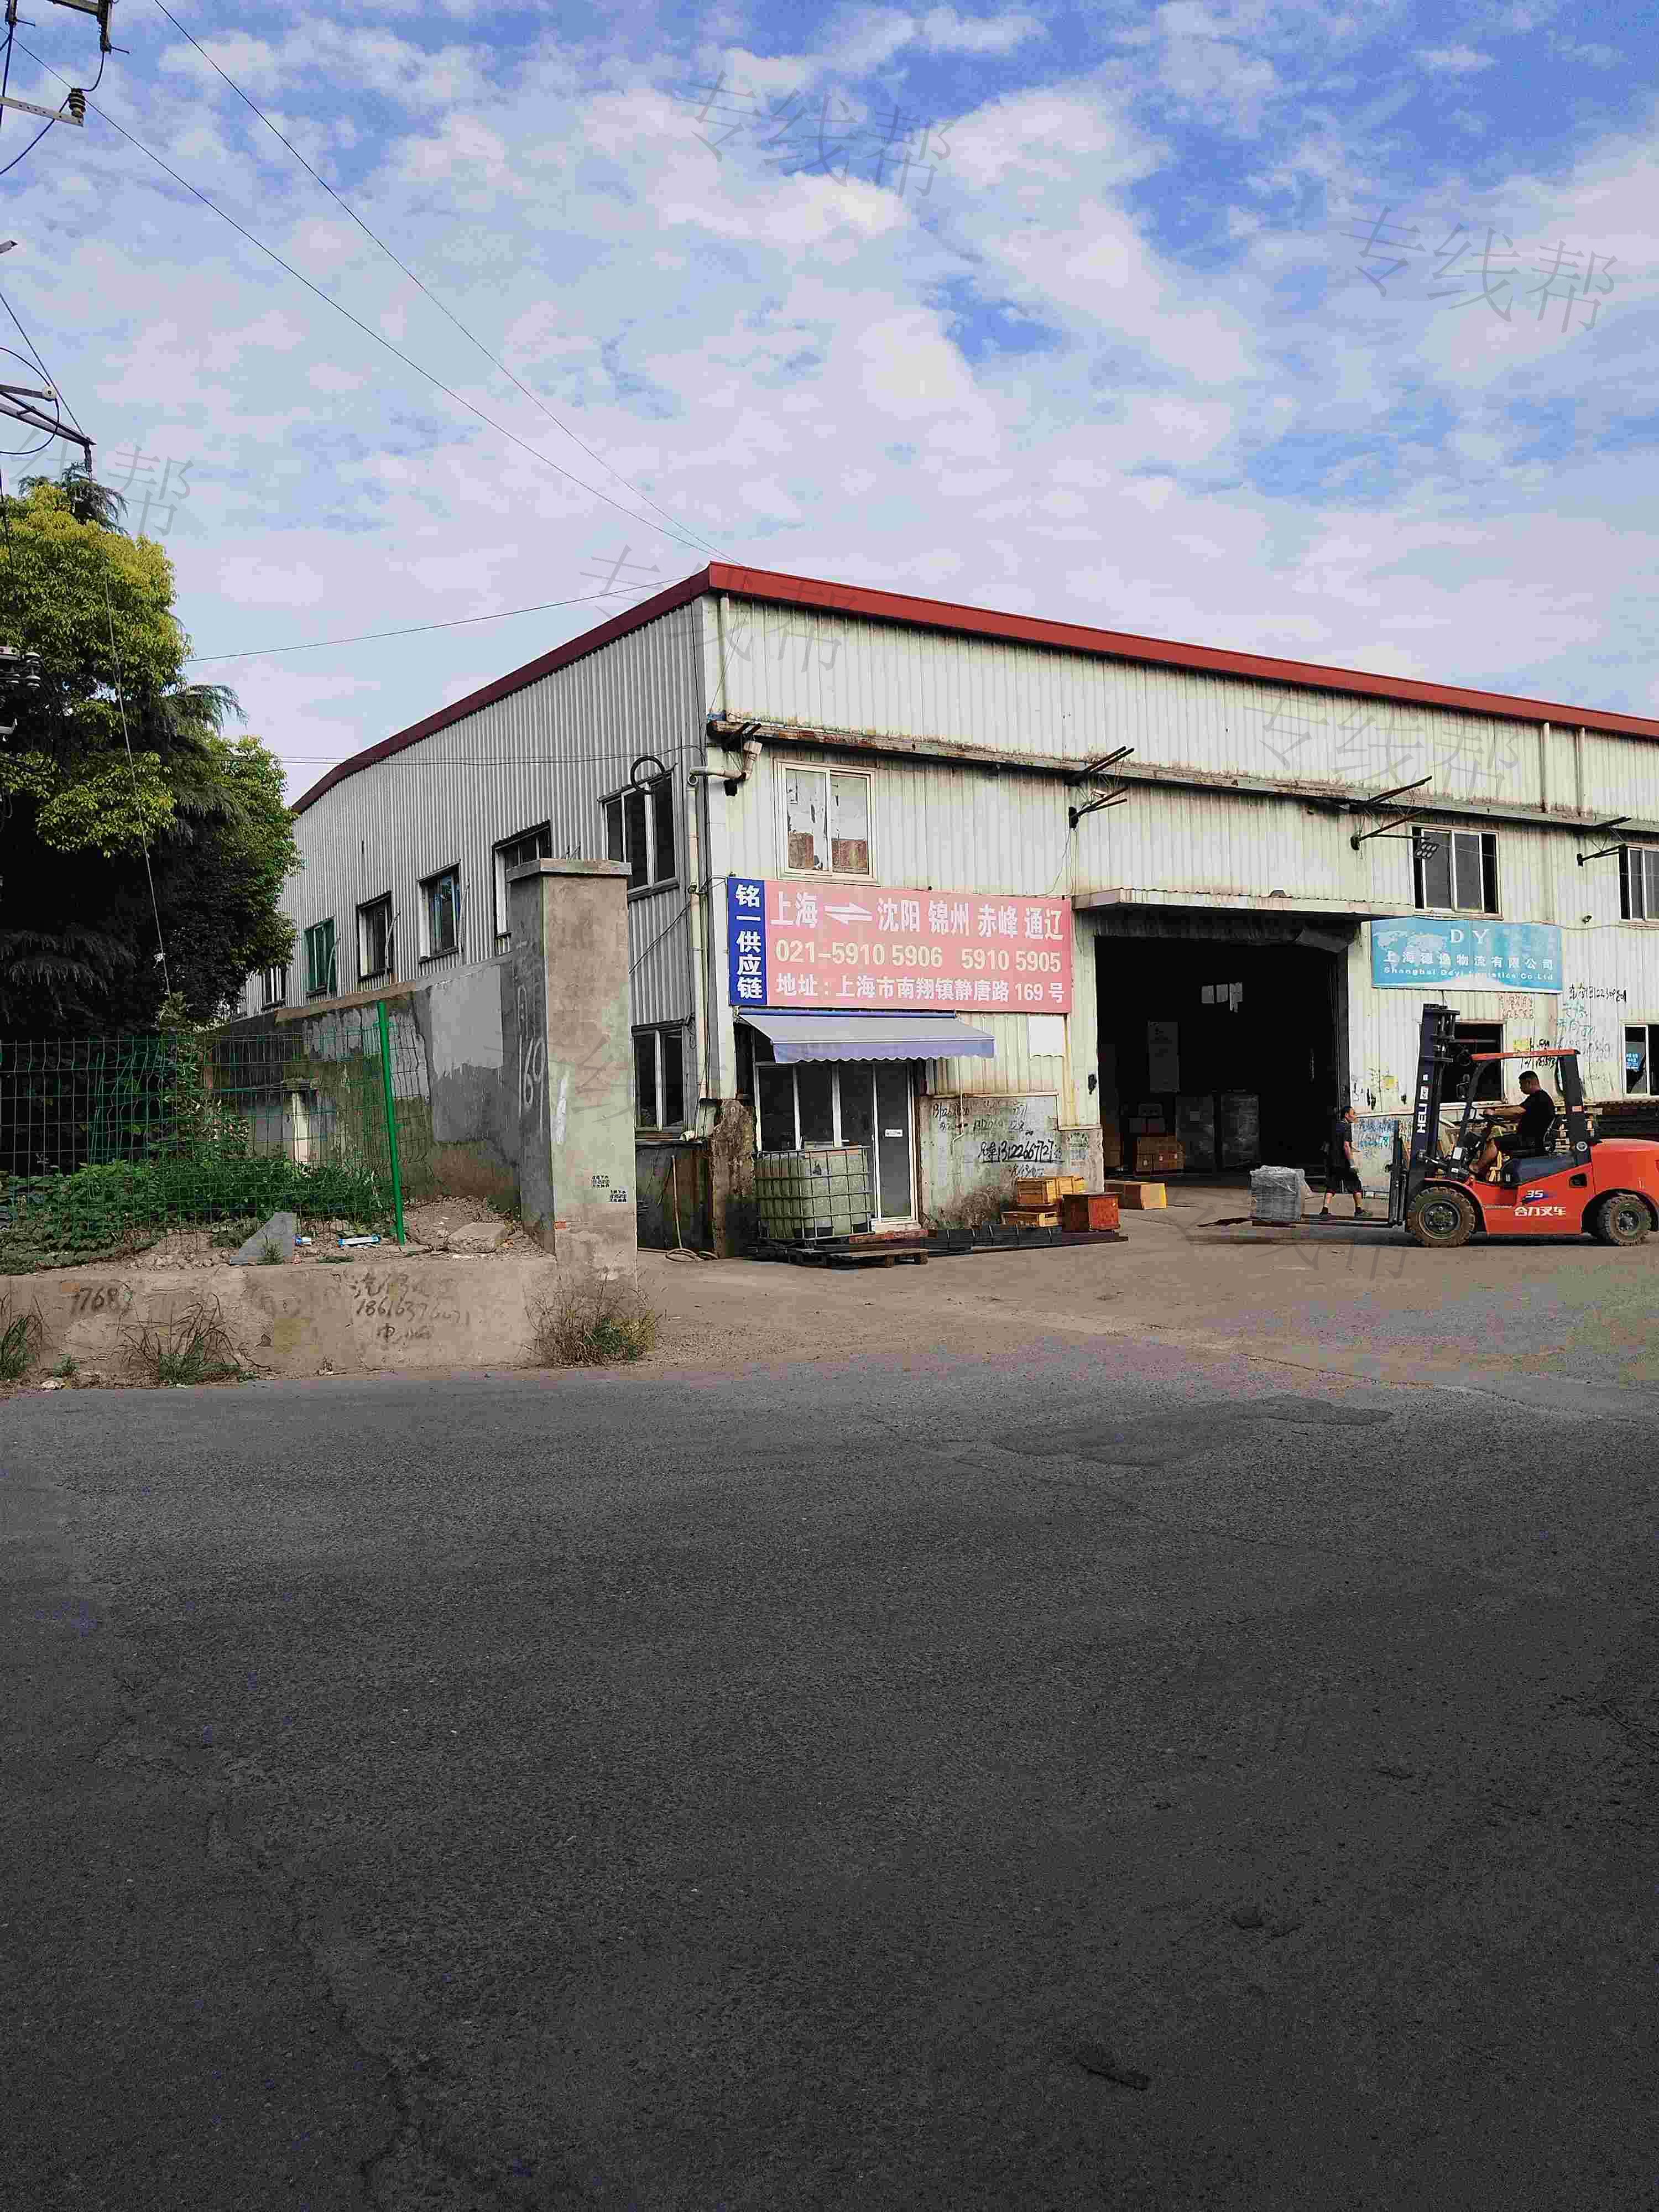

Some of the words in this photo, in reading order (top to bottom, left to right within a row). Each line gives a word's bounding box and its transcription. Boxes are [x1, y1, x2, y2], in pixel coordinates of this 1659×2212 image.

[770, 891, 818, 929] 上海
[877, 898, 921, 933] 沈阳
[928, 900, 969, 937] 锦州
[978, 904, 1018, 938] 赤峰
[1024, 906, 1063, 941] 通辽
[735, 884, 763, 1000] 铭一供应链
[775, 940, 885, 966] 021-5910
[892, 944, 943, 968] 5906
[961, 948, 1009, 971] 5910
[1016, 950, 1061, 973] 5905
[1015, 983, 1044, 1001] 169
[1048, 984, 1065, 1004] 号
[1416, 1103, 1428, 1134] HELI
[1526, 1190, 1544, 1198] 35
[1514, 1206, 1567, 1217] 合力叉车
